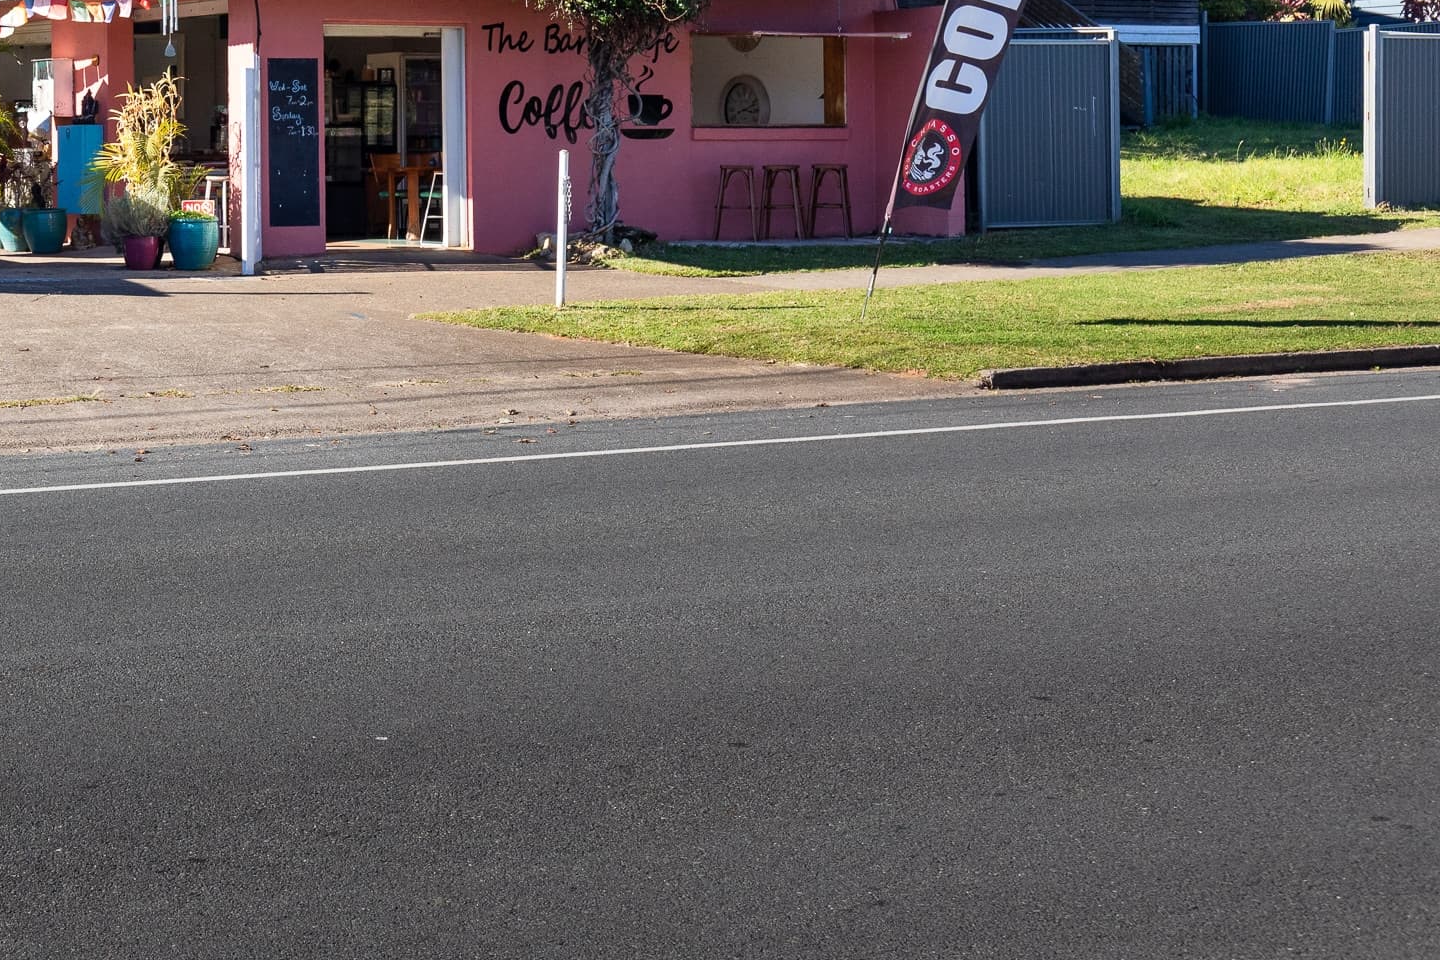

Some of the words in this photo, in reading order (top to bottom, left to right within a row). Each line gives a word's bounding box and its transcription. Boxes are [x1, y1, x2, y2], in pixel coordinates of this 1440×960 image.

[481, 21, 536, 54] The
[544, 23, 591, 55] Bar
[911, 119, 960, 156] CHIASSO
